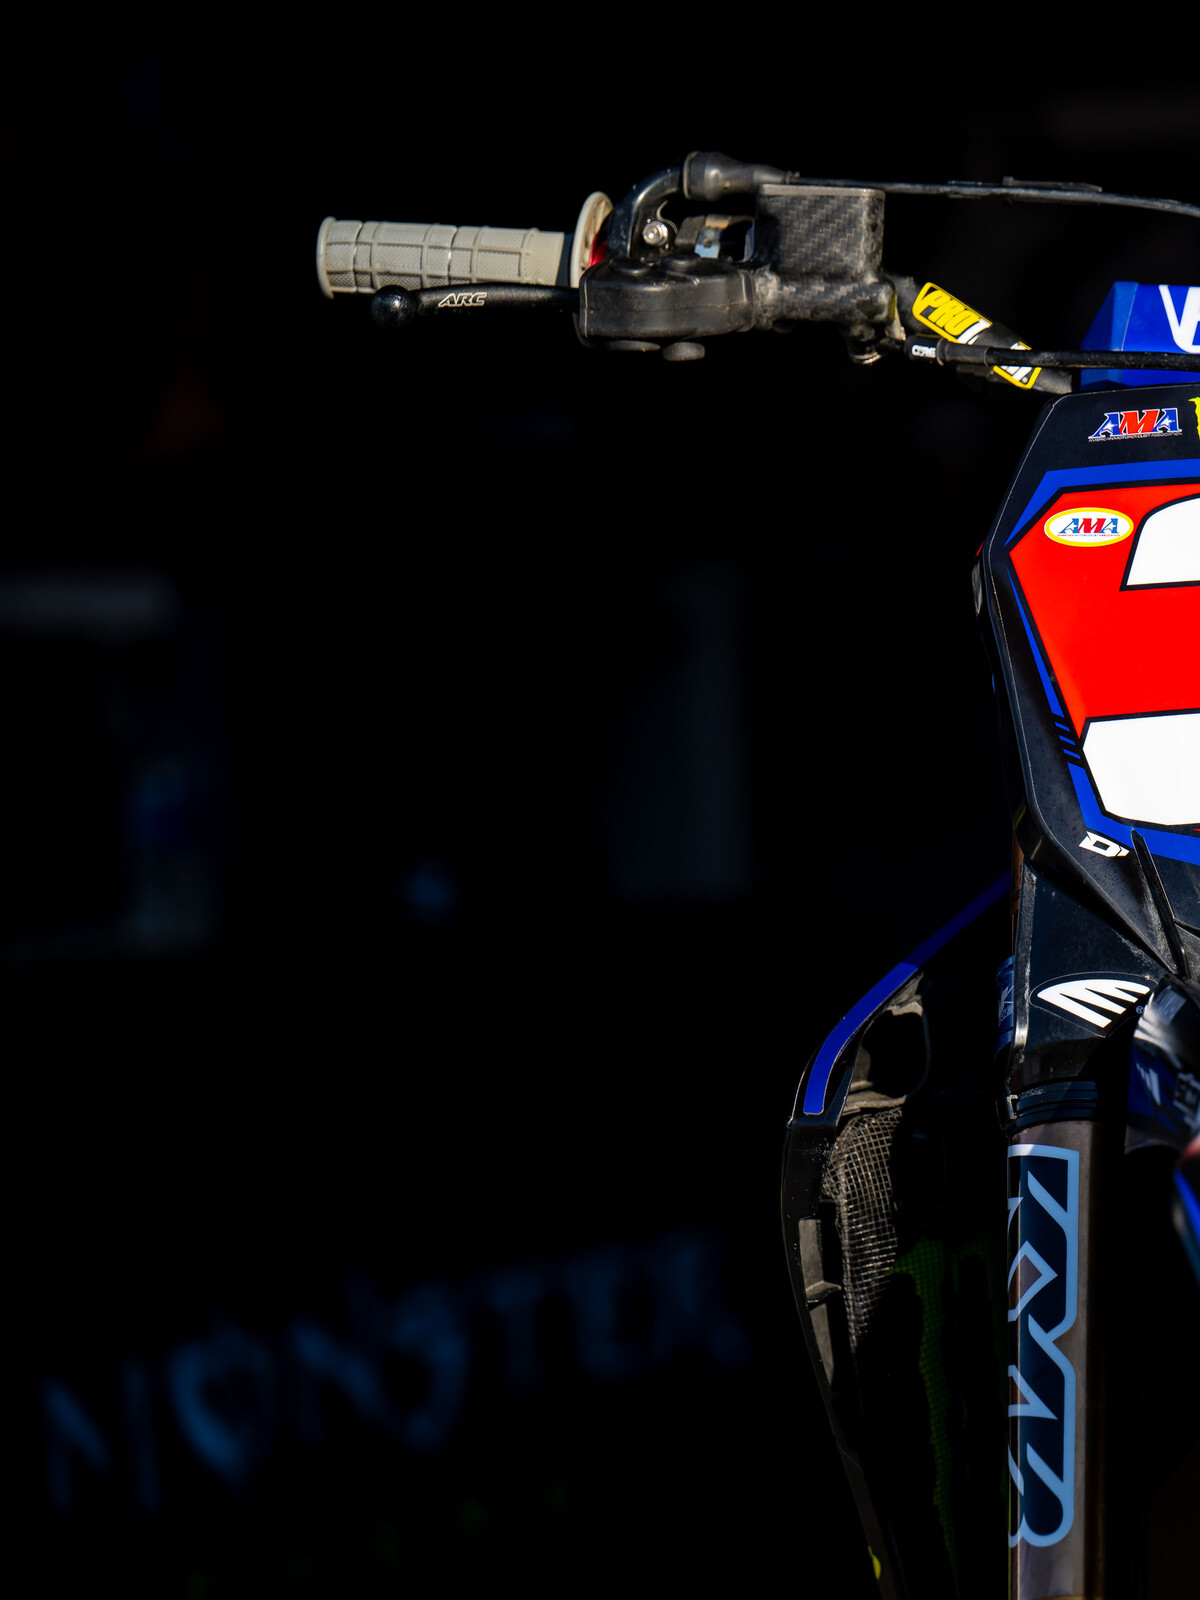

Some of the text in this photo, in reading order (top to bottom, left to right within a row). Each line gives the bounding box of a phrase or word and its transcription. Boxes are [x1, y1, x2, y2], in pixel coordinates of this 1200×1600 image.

[439, 292, 487, 307] ARC
[1088, 408, 1182, 438] AMA
[1058, 517, 1119, 534] AMA
